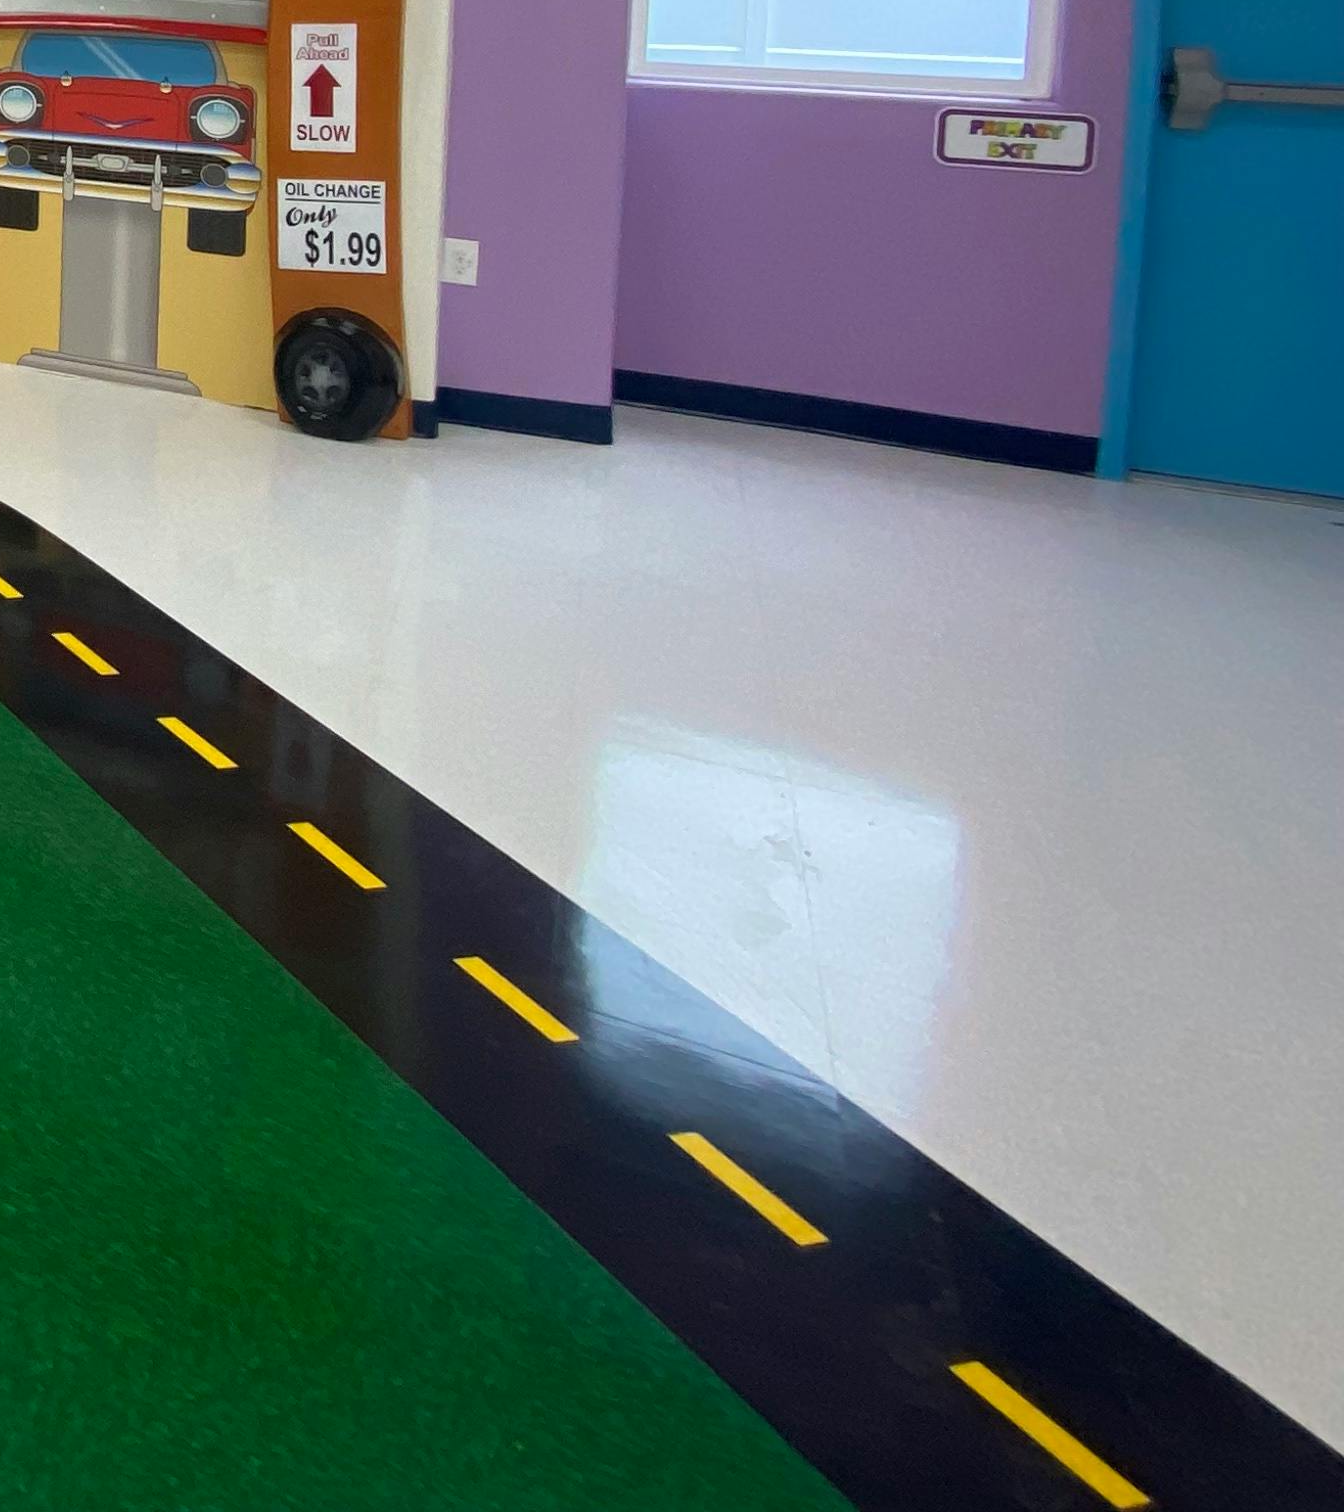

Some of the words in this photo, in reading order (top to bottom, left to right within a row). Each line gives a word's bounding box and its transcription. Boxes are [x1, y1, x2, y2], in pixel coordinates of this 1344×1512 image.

[306, 33, 339, 47] Pull
[296, 47, 349, 60] Ahead
[297, 124, 350, 142] SLOW
[987, 142, 1037, 159] EXIT
[285, 182, 309, 196] OIL
[314, 184, 381, 199] CHANGE
[286, 205, 338, 228] Only
[305, 228, 381, 267] $1.99
